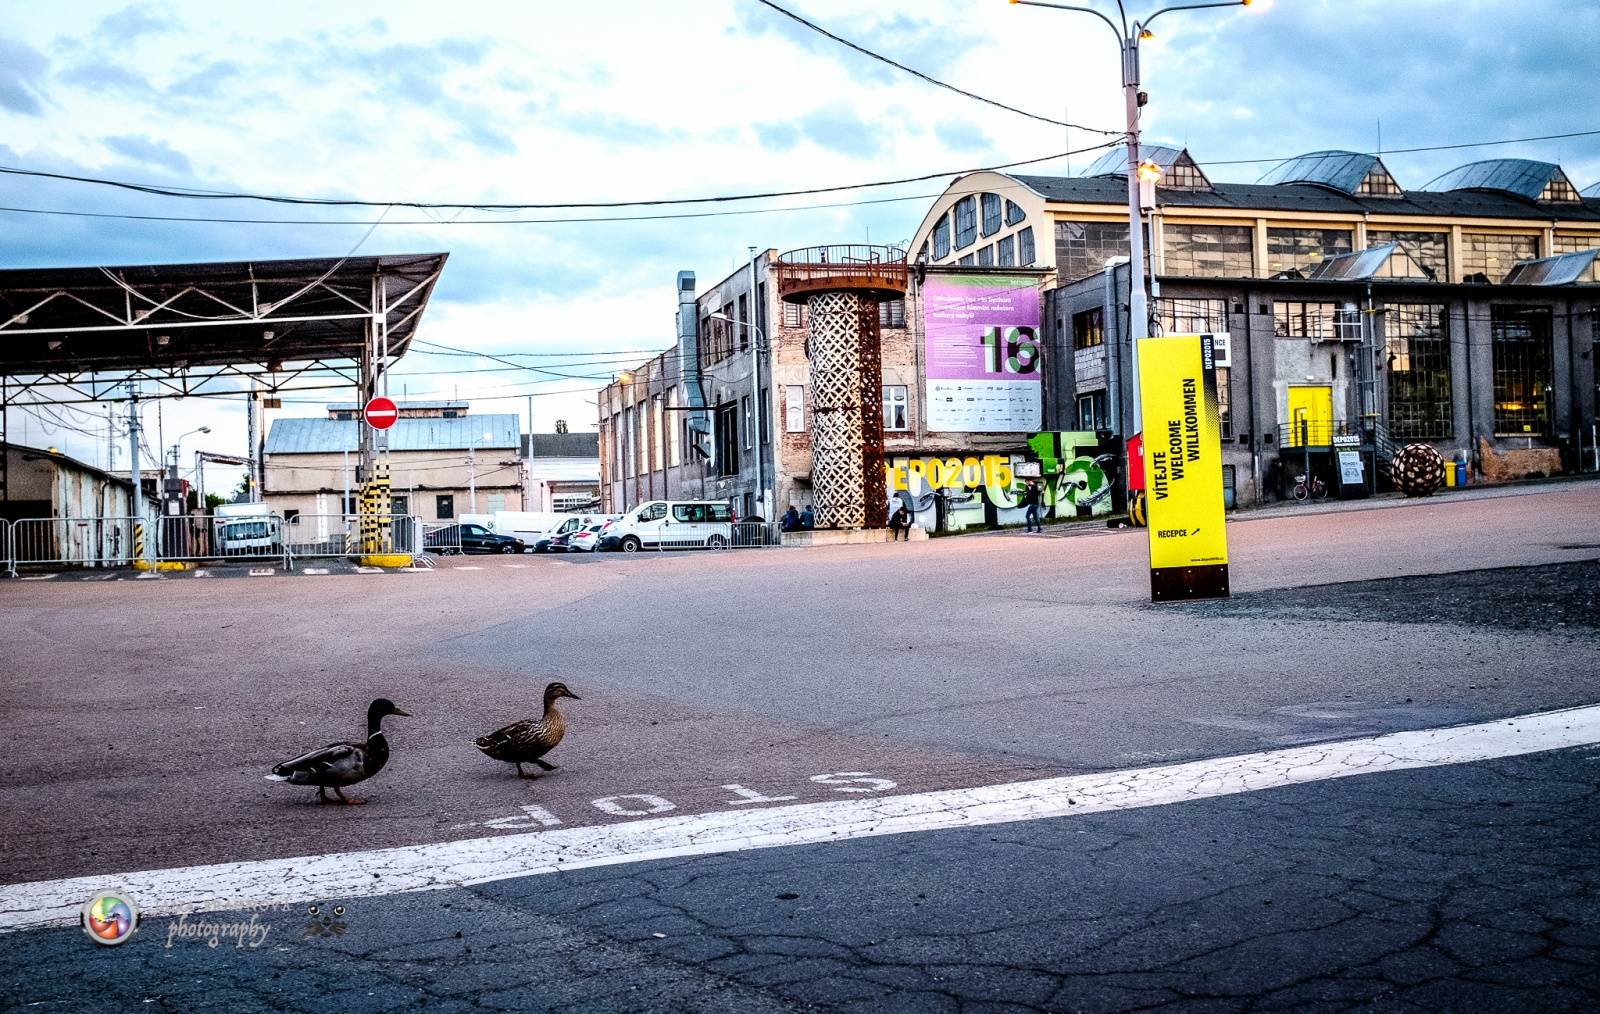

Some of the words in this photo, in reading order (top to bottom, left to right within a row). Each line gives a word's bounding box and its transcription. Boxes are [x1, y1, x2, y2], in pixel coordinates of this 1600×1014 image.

[1203, 338, 1213, 370] DEPO2015
[1182, 378, 1200, 462] WILLKOMMEN
[1168, 420, 1184, 481] WELCOME
[1152, 452, 1168, 500] VÍTEJTE
[1158, 529, 1187, 538] RECEPCE
